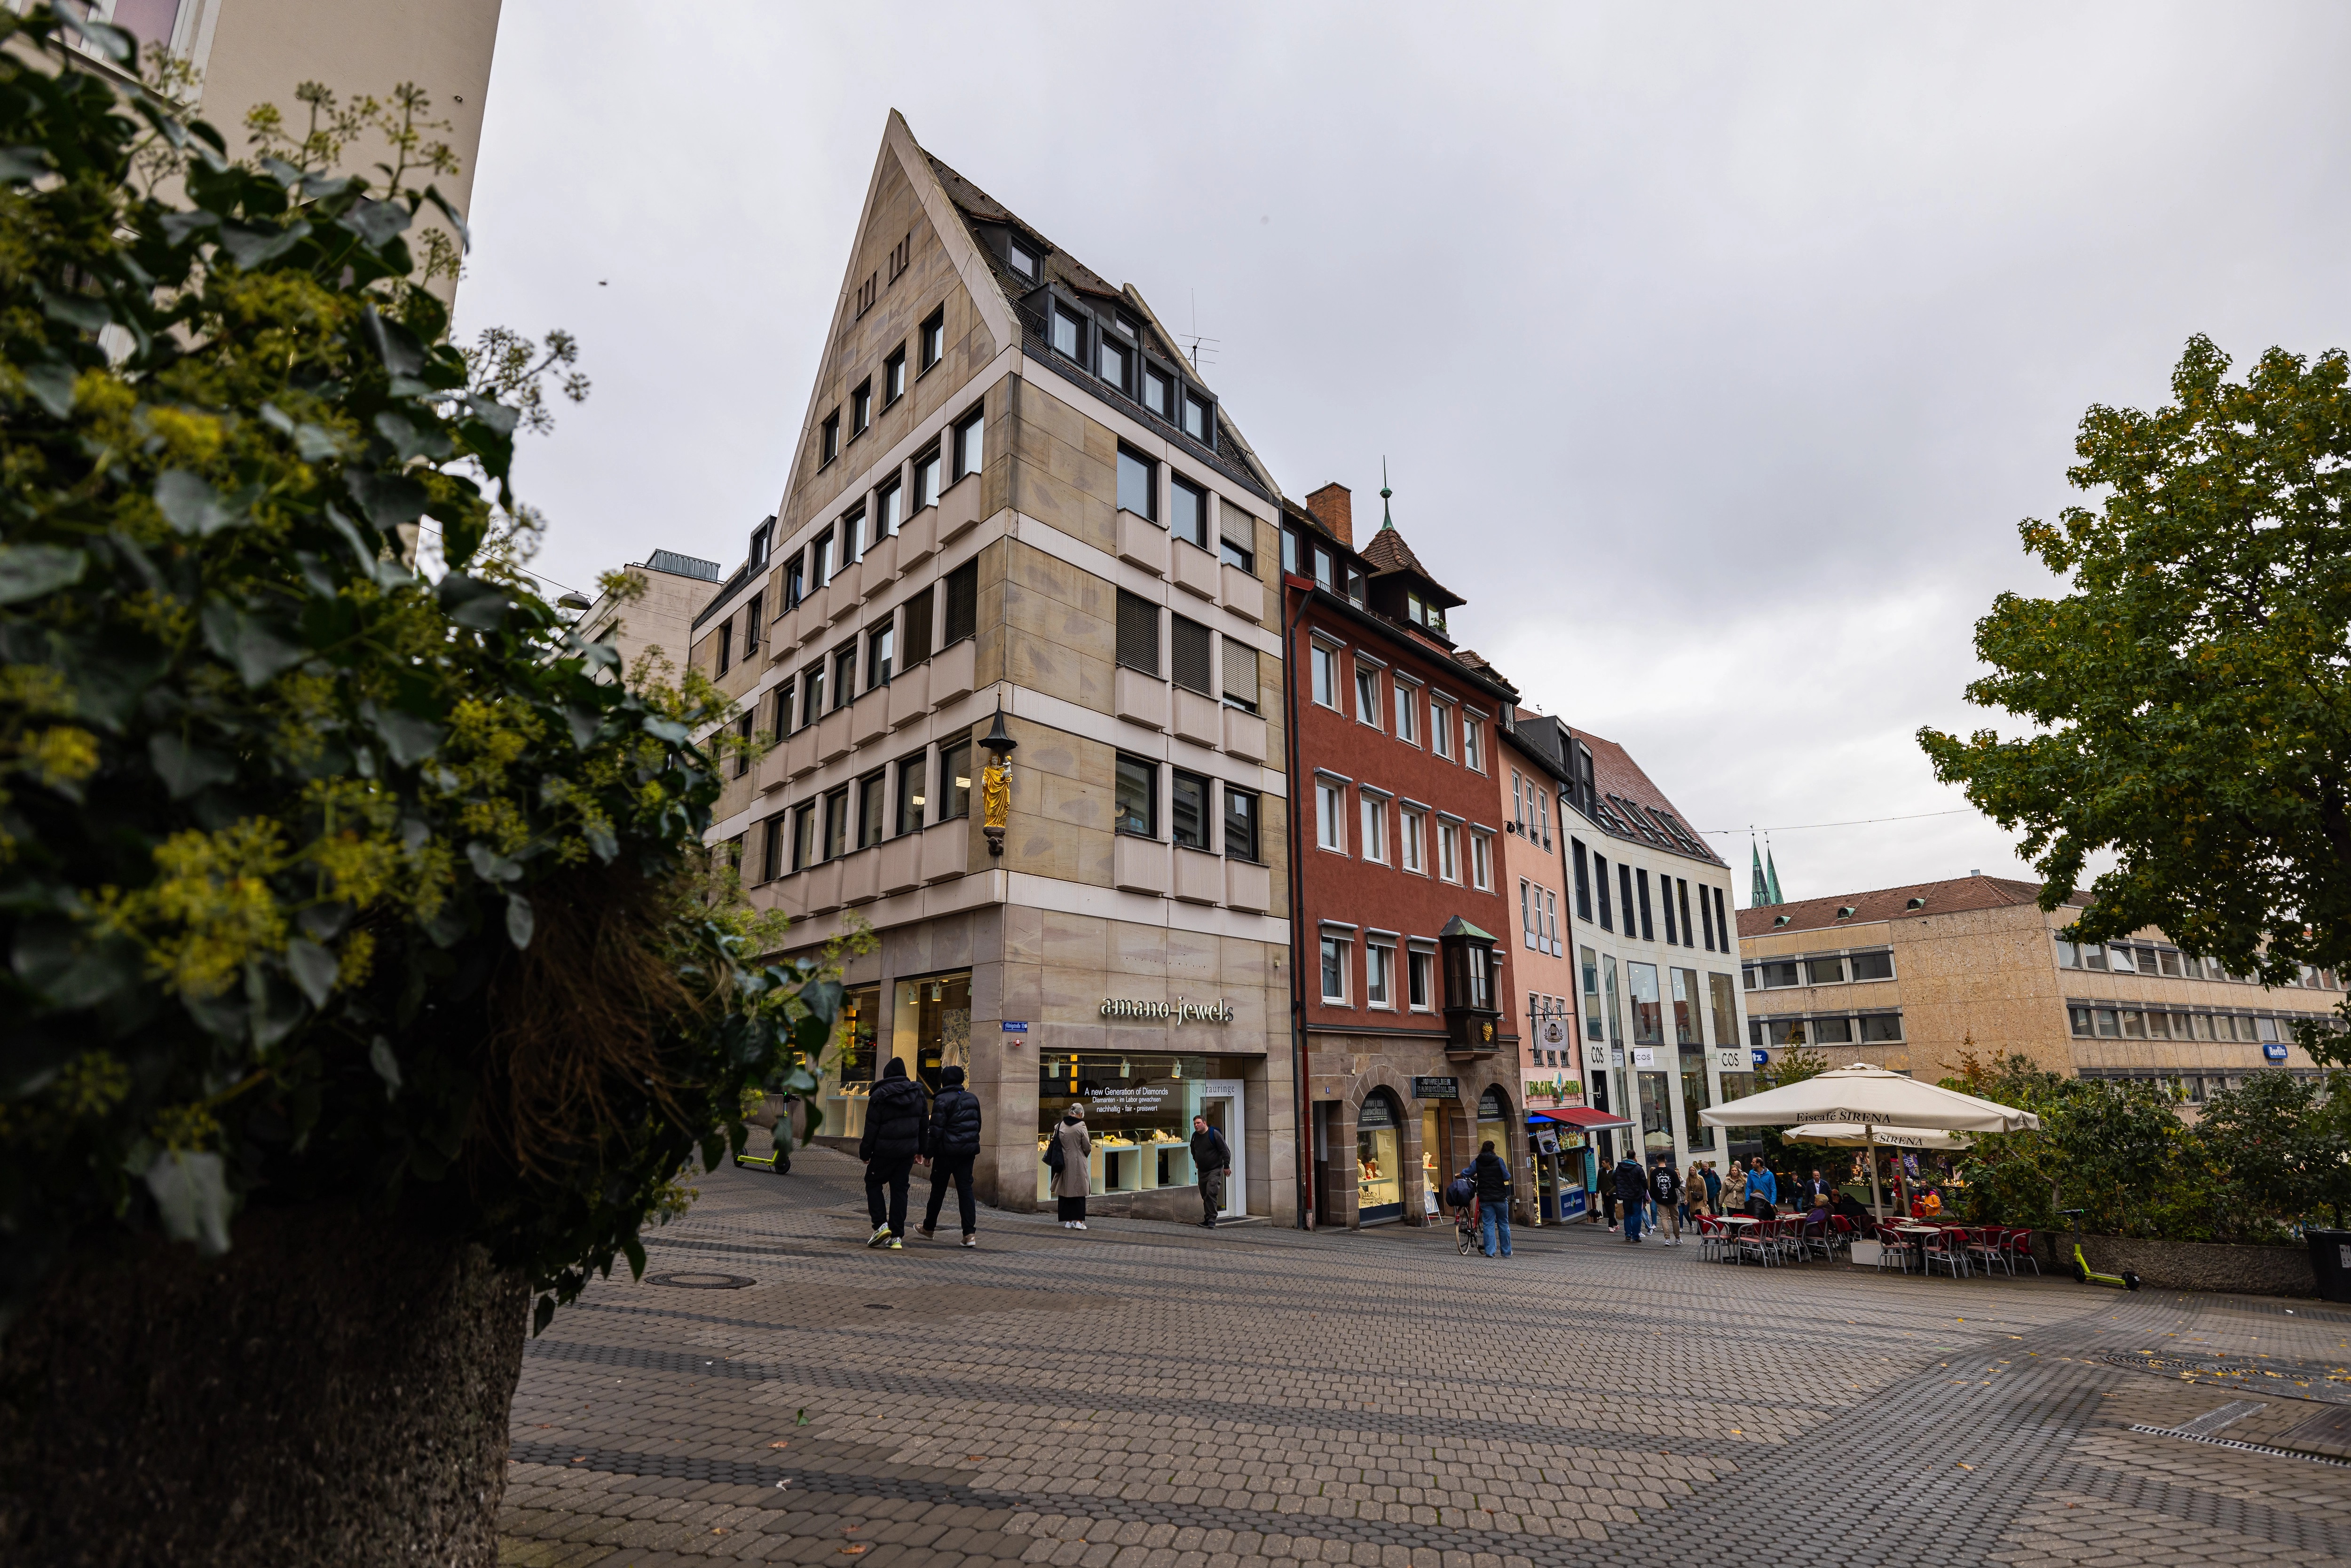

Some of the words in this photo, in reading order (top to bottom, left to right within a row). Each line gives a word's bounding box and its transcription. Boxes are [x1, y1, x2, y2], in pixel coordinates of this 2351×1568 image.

[1101, 998, 1171, 1018] amano
[1177, 996, 1233, 1026] jewels
[1591, 1046, 1604, 1064] COS
[2269, 1046, 2286, 1056] Berlitz
[1722, 1053, 1739, 1066] COS
[1084, 1087, 1089, 1095] A
[1104, 1087, 1134, 1095] Generation
[1136, 1087, 1141, 1095] of
[1143, 1087, 1168, 1095] Diamonds
[1201, 1084, 1235, 1095] Trauringe
[1097, 1105, 1120, 1113] nachhaltig
[1796, 1111, 1837, 1122] Eiscafé
[1839, 1111, 1891, 1123] SIRENA
[1879, 1135, 1923, 1146] SIRENA
